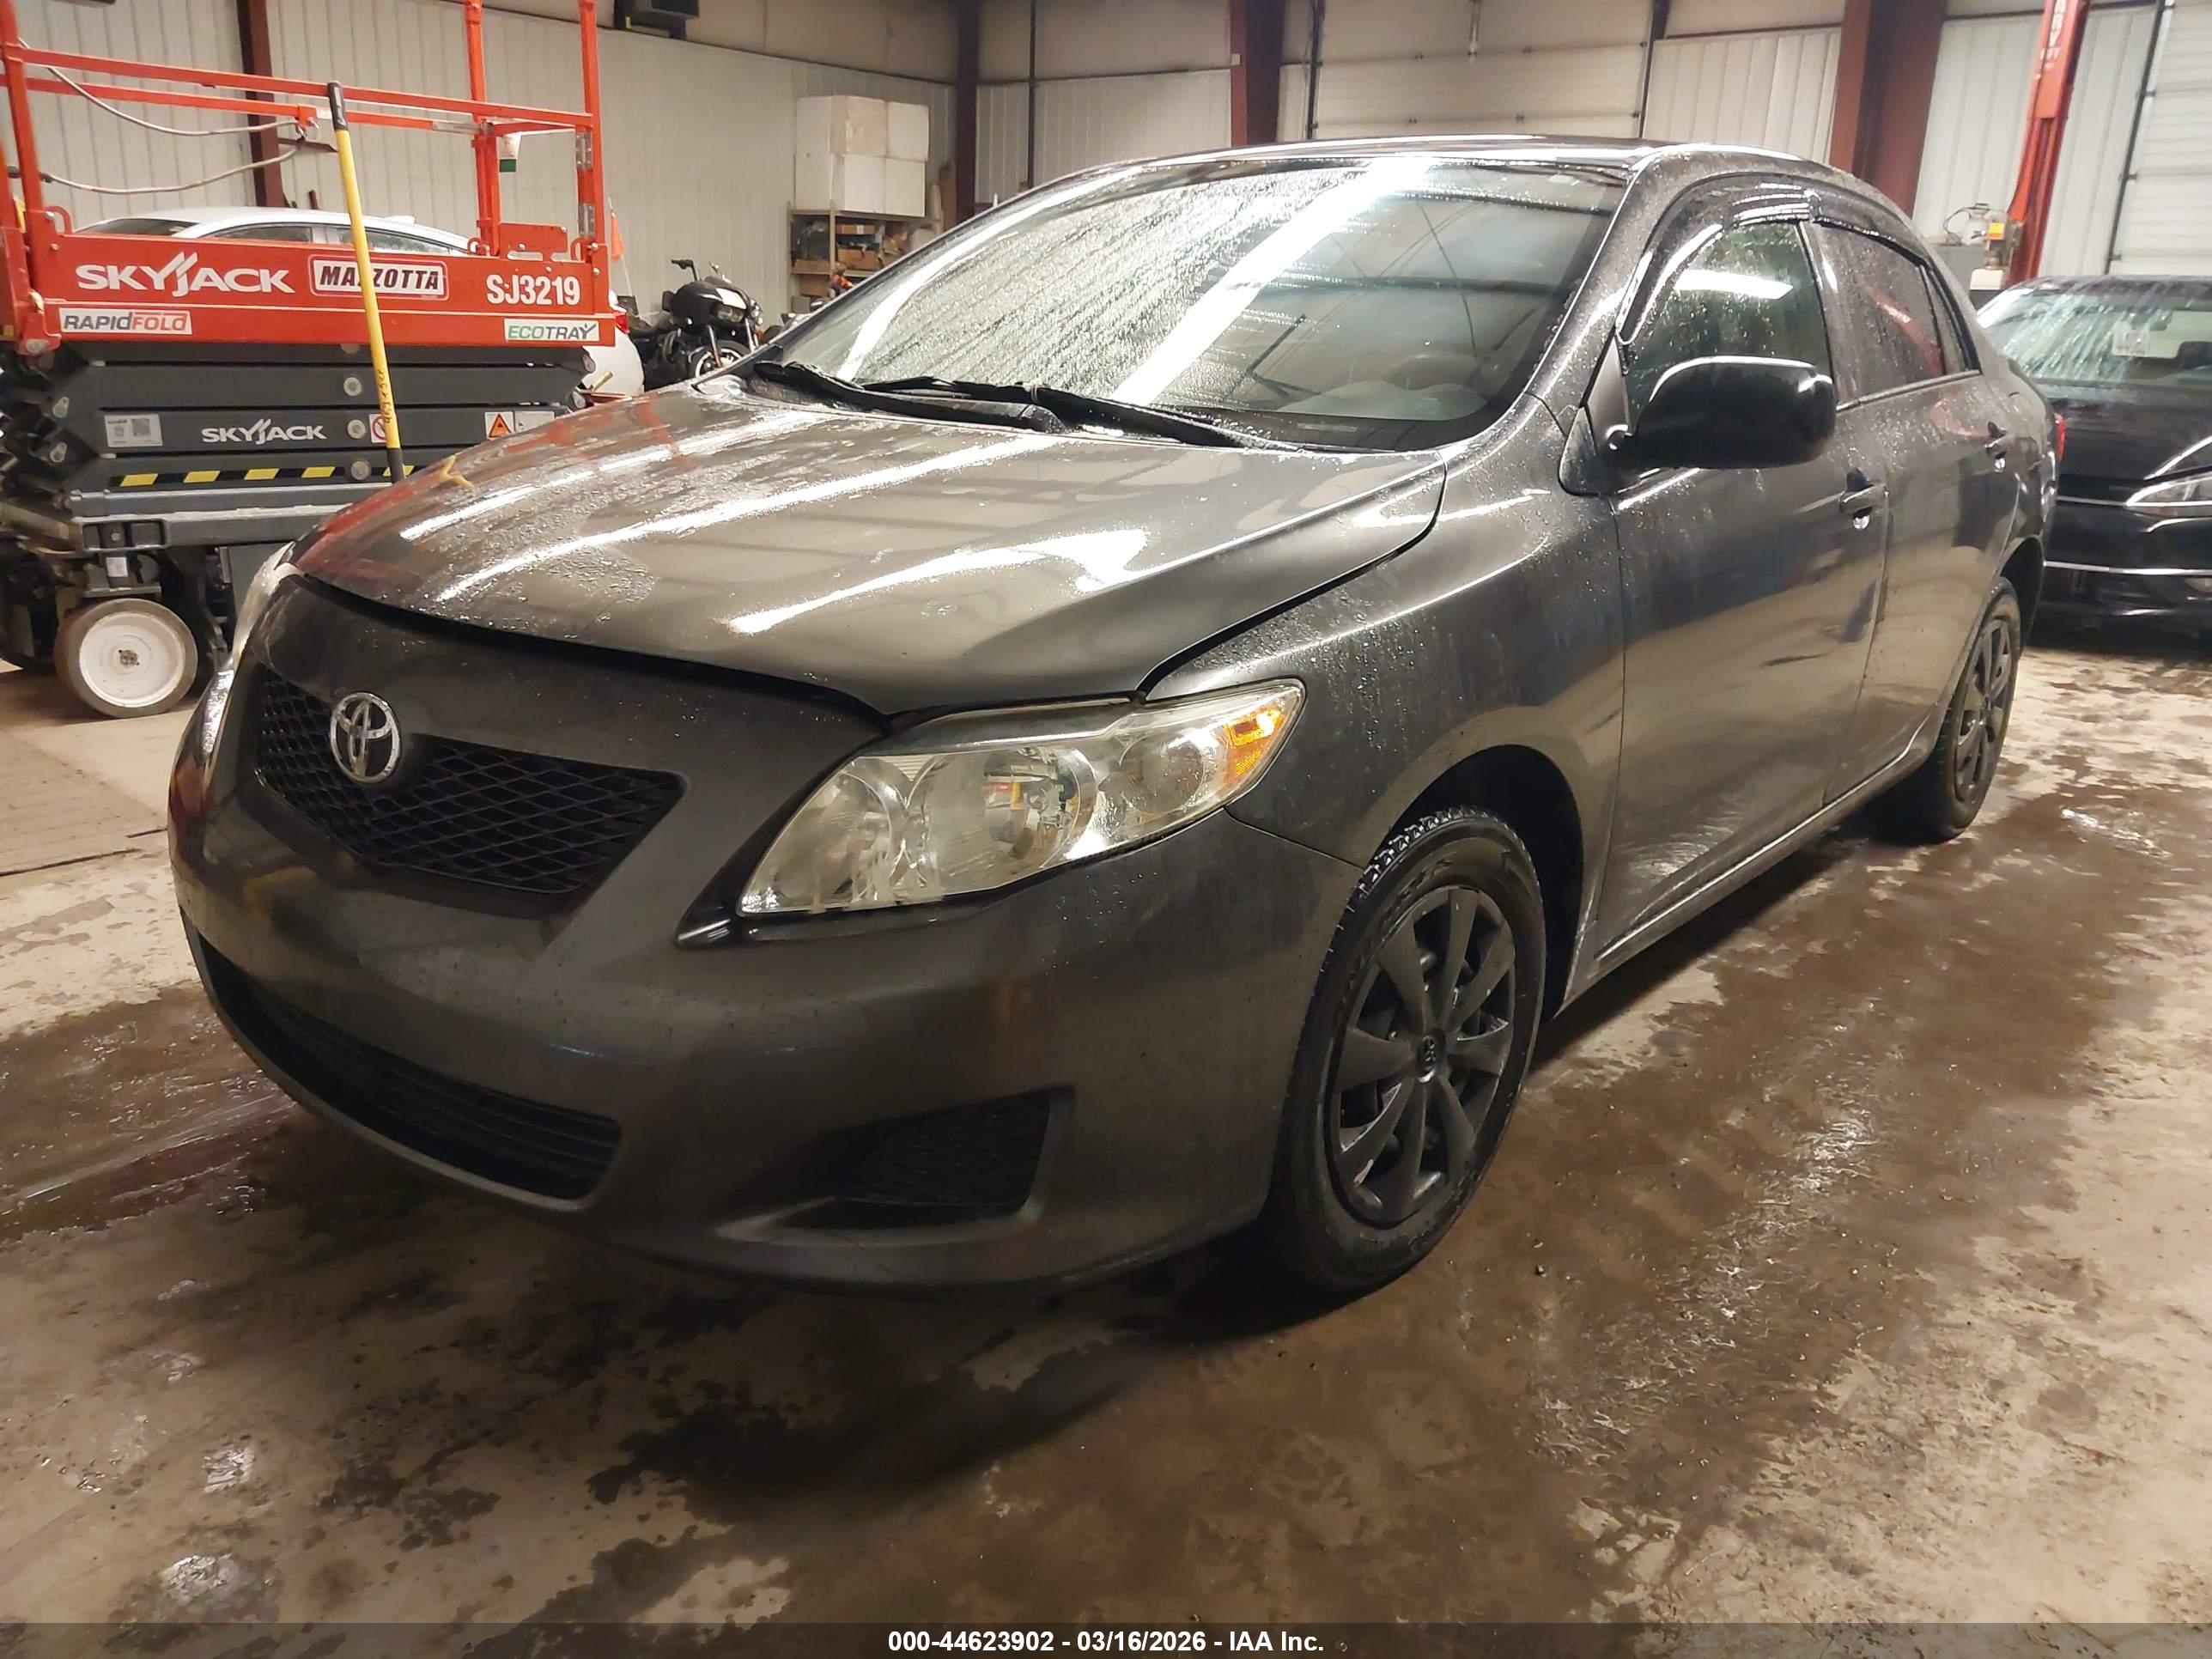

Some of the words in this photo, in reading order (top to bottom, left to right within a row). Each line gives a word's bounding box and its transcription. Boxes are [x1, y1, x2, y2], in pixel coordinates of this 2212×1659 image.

[75, 251, 296, 297] SKYJACK
[319, 264, 441, 290] MAZOTTA
[486, 274, 580, 305] SJ3219
[507, 323, 597, 340] ECOTRAY
[201, 418, 327, 445] SKYJACK
